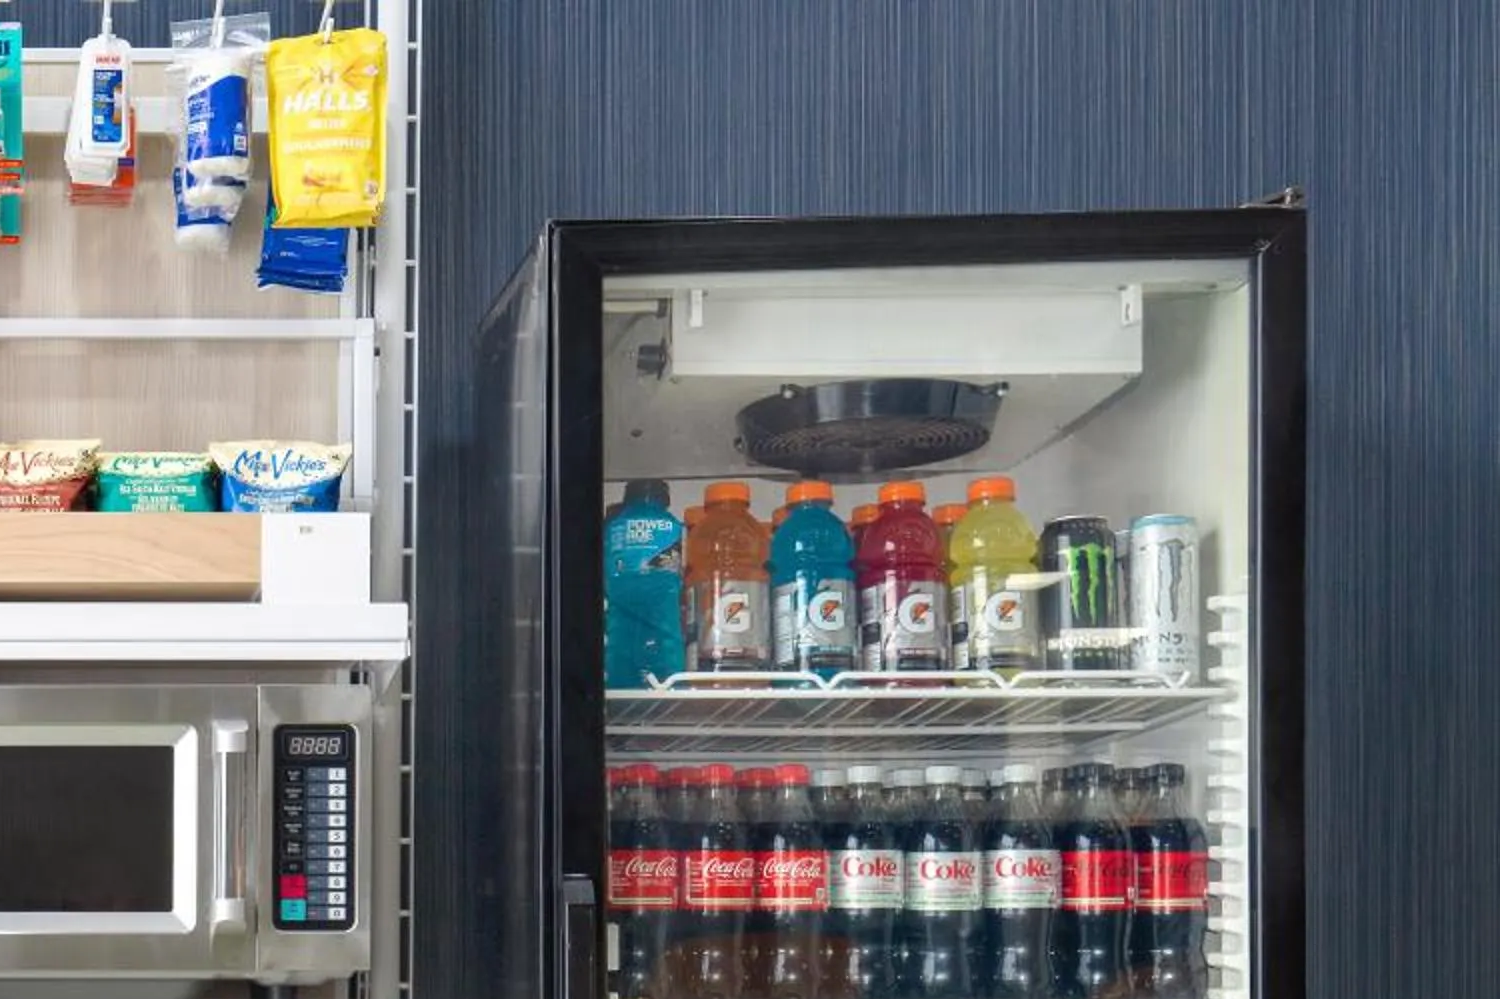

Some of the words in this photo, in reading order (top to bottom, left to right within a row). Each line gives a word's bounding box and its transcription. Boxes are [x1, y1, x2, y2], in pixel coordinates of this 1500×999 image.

[283, 91, 369, 114] HALLS
[270, 448, 328, 480] Vickie's
[842, 855, 898, 878] Coke
[919, 857, 976, 880] Coke
[994, 856, 1053, 879] Coke
